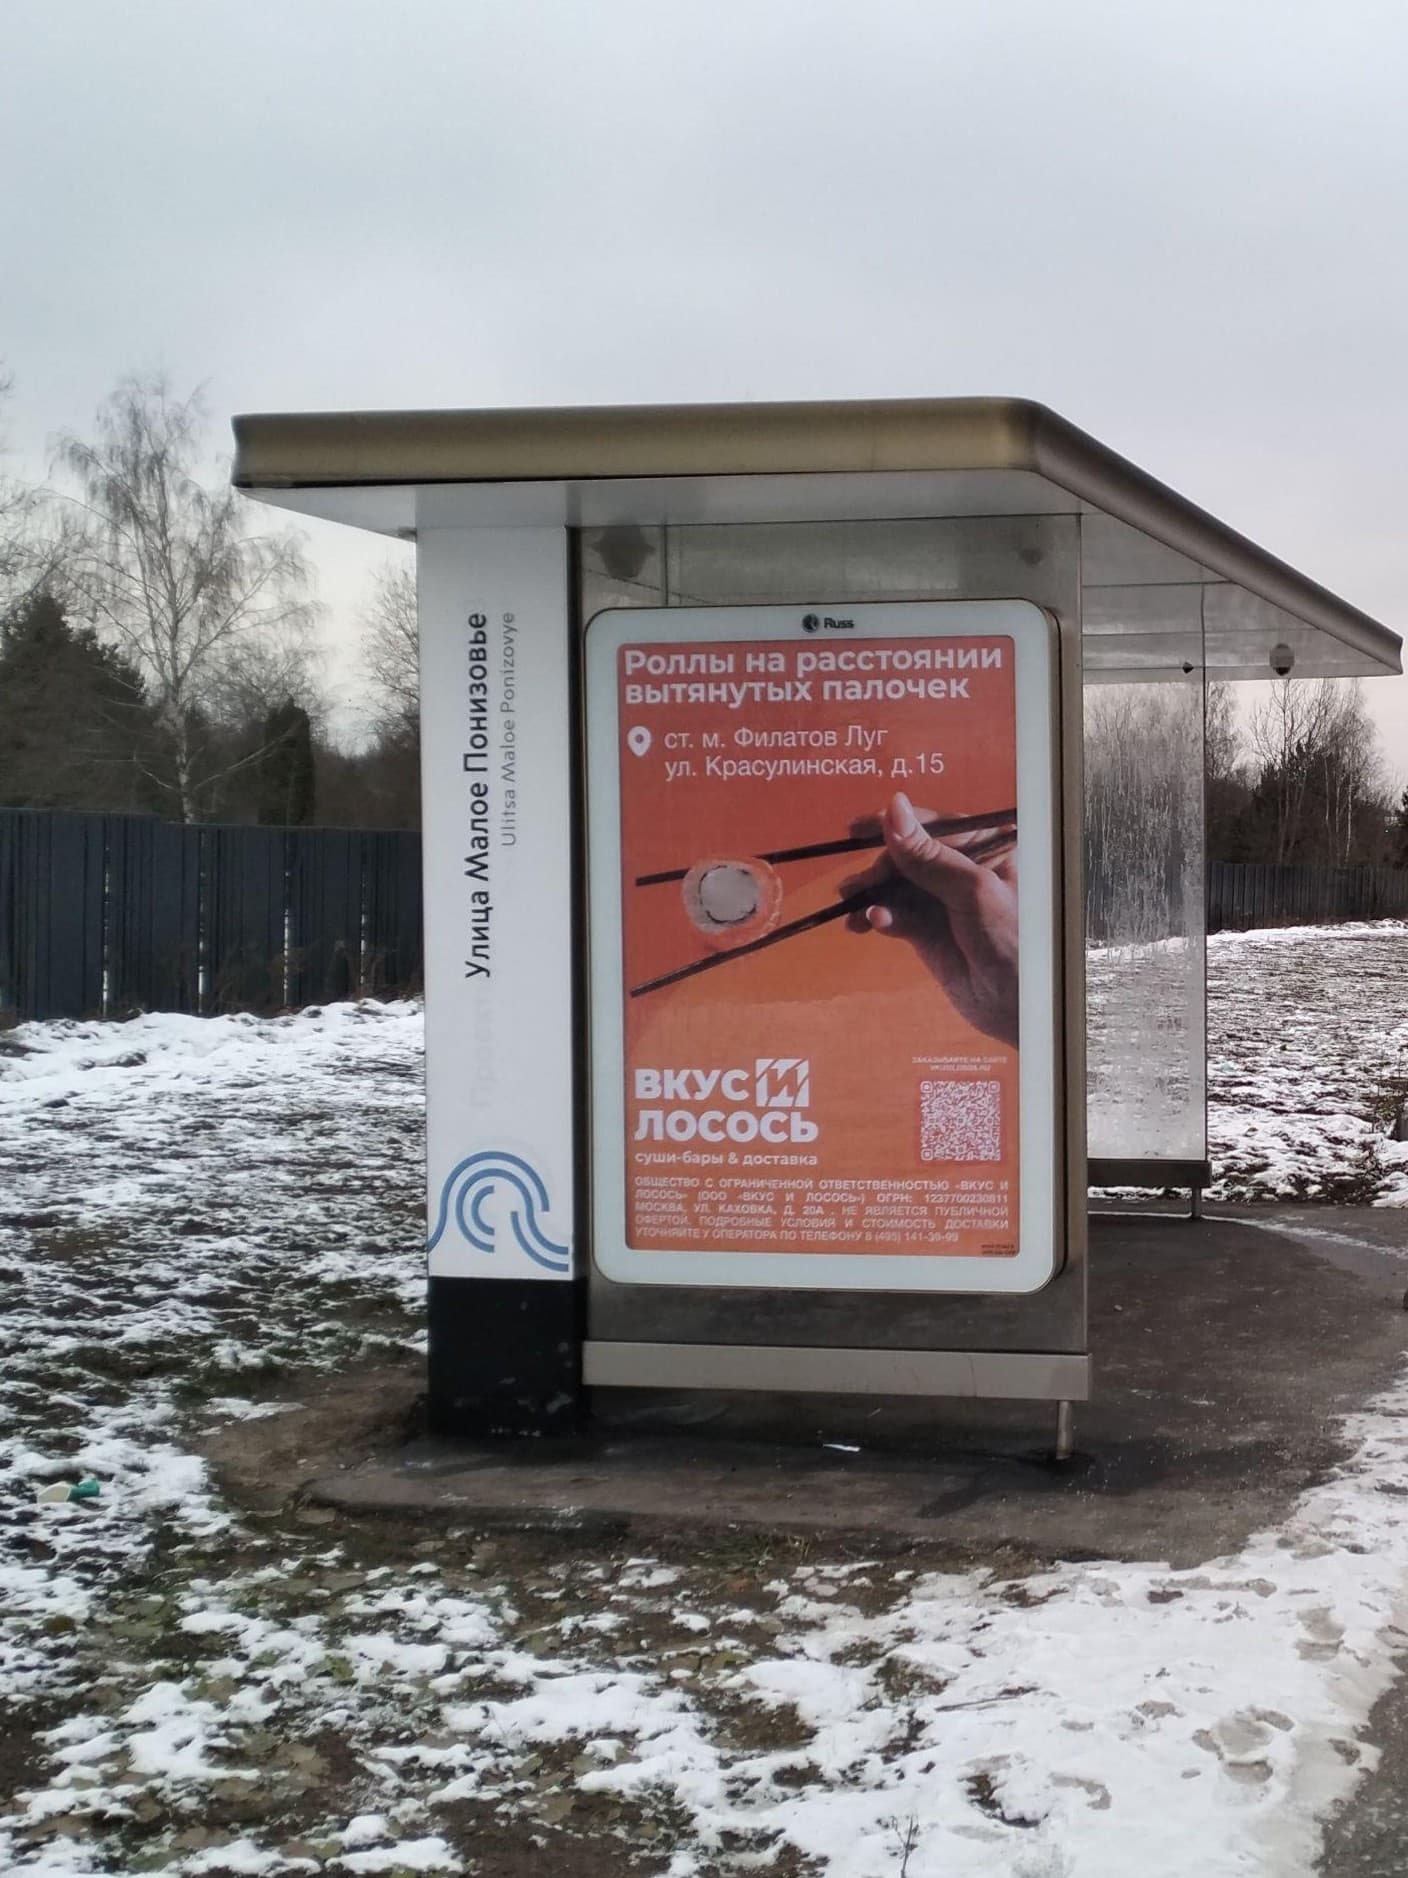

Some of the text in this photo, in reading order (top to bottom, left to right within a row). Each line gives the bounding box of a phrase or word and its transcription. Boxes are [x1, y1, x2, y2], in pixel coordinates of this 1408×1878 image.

[824, 617, 854, 629] Russ
[625, 647, 1002, 678] Роллы на расстоянии
[625, 677, 970, 708] вытянутых палочек
[499, 612, 518, 846] Ulitsa Maloe Ponizovye
[664, 725, 888, 751] ст. м. Филатов Луг
[664, 752, 944, 782] ул. Красулинская, д.15
[463, 612, 493, 978] Улица Малое Понизовье
[634, 1068, 749, 1101] ВКУС
[634, 1109, 819, 1144] ЛОСОСЬ
[634, 1150, 818, 1167] суши-бары & доставка
[634, 1176, 700, 1187] ОБЩЕСТВО
[705, 1178, 714, 1188] С
[718, 1178, 813, 1190] ОГРАНИЧЕННОЙ
[819, 1179, 949, 1191] ОТВЕТСТВЕННОСТЬЮ
[785, 1192, 795, 1203] И
[699, 1215, 773, 1228] ПОДРОБНЫЕ
[781, 1217, 836, 1228] УСЛОВИЯ
[862, 1218, 937, 1229] СТОИМОСТЬ
[944, 1218, 1008, 1230] ДОСТАВКИ
[841, 1206, 857, 1216] НЕ
[865, 1206, 928, 1217] ЯВЛЯЕТСЯ
[935, 1205, 1008, 1218] ПУБЛИЧНОЙ
[712, 1229, 777, 1240] ОПЕРАТОРА
[780, 1230, 797, 1241] ПО
[800, 1230, 862, 1241] ТЕЛЕФОНУ
